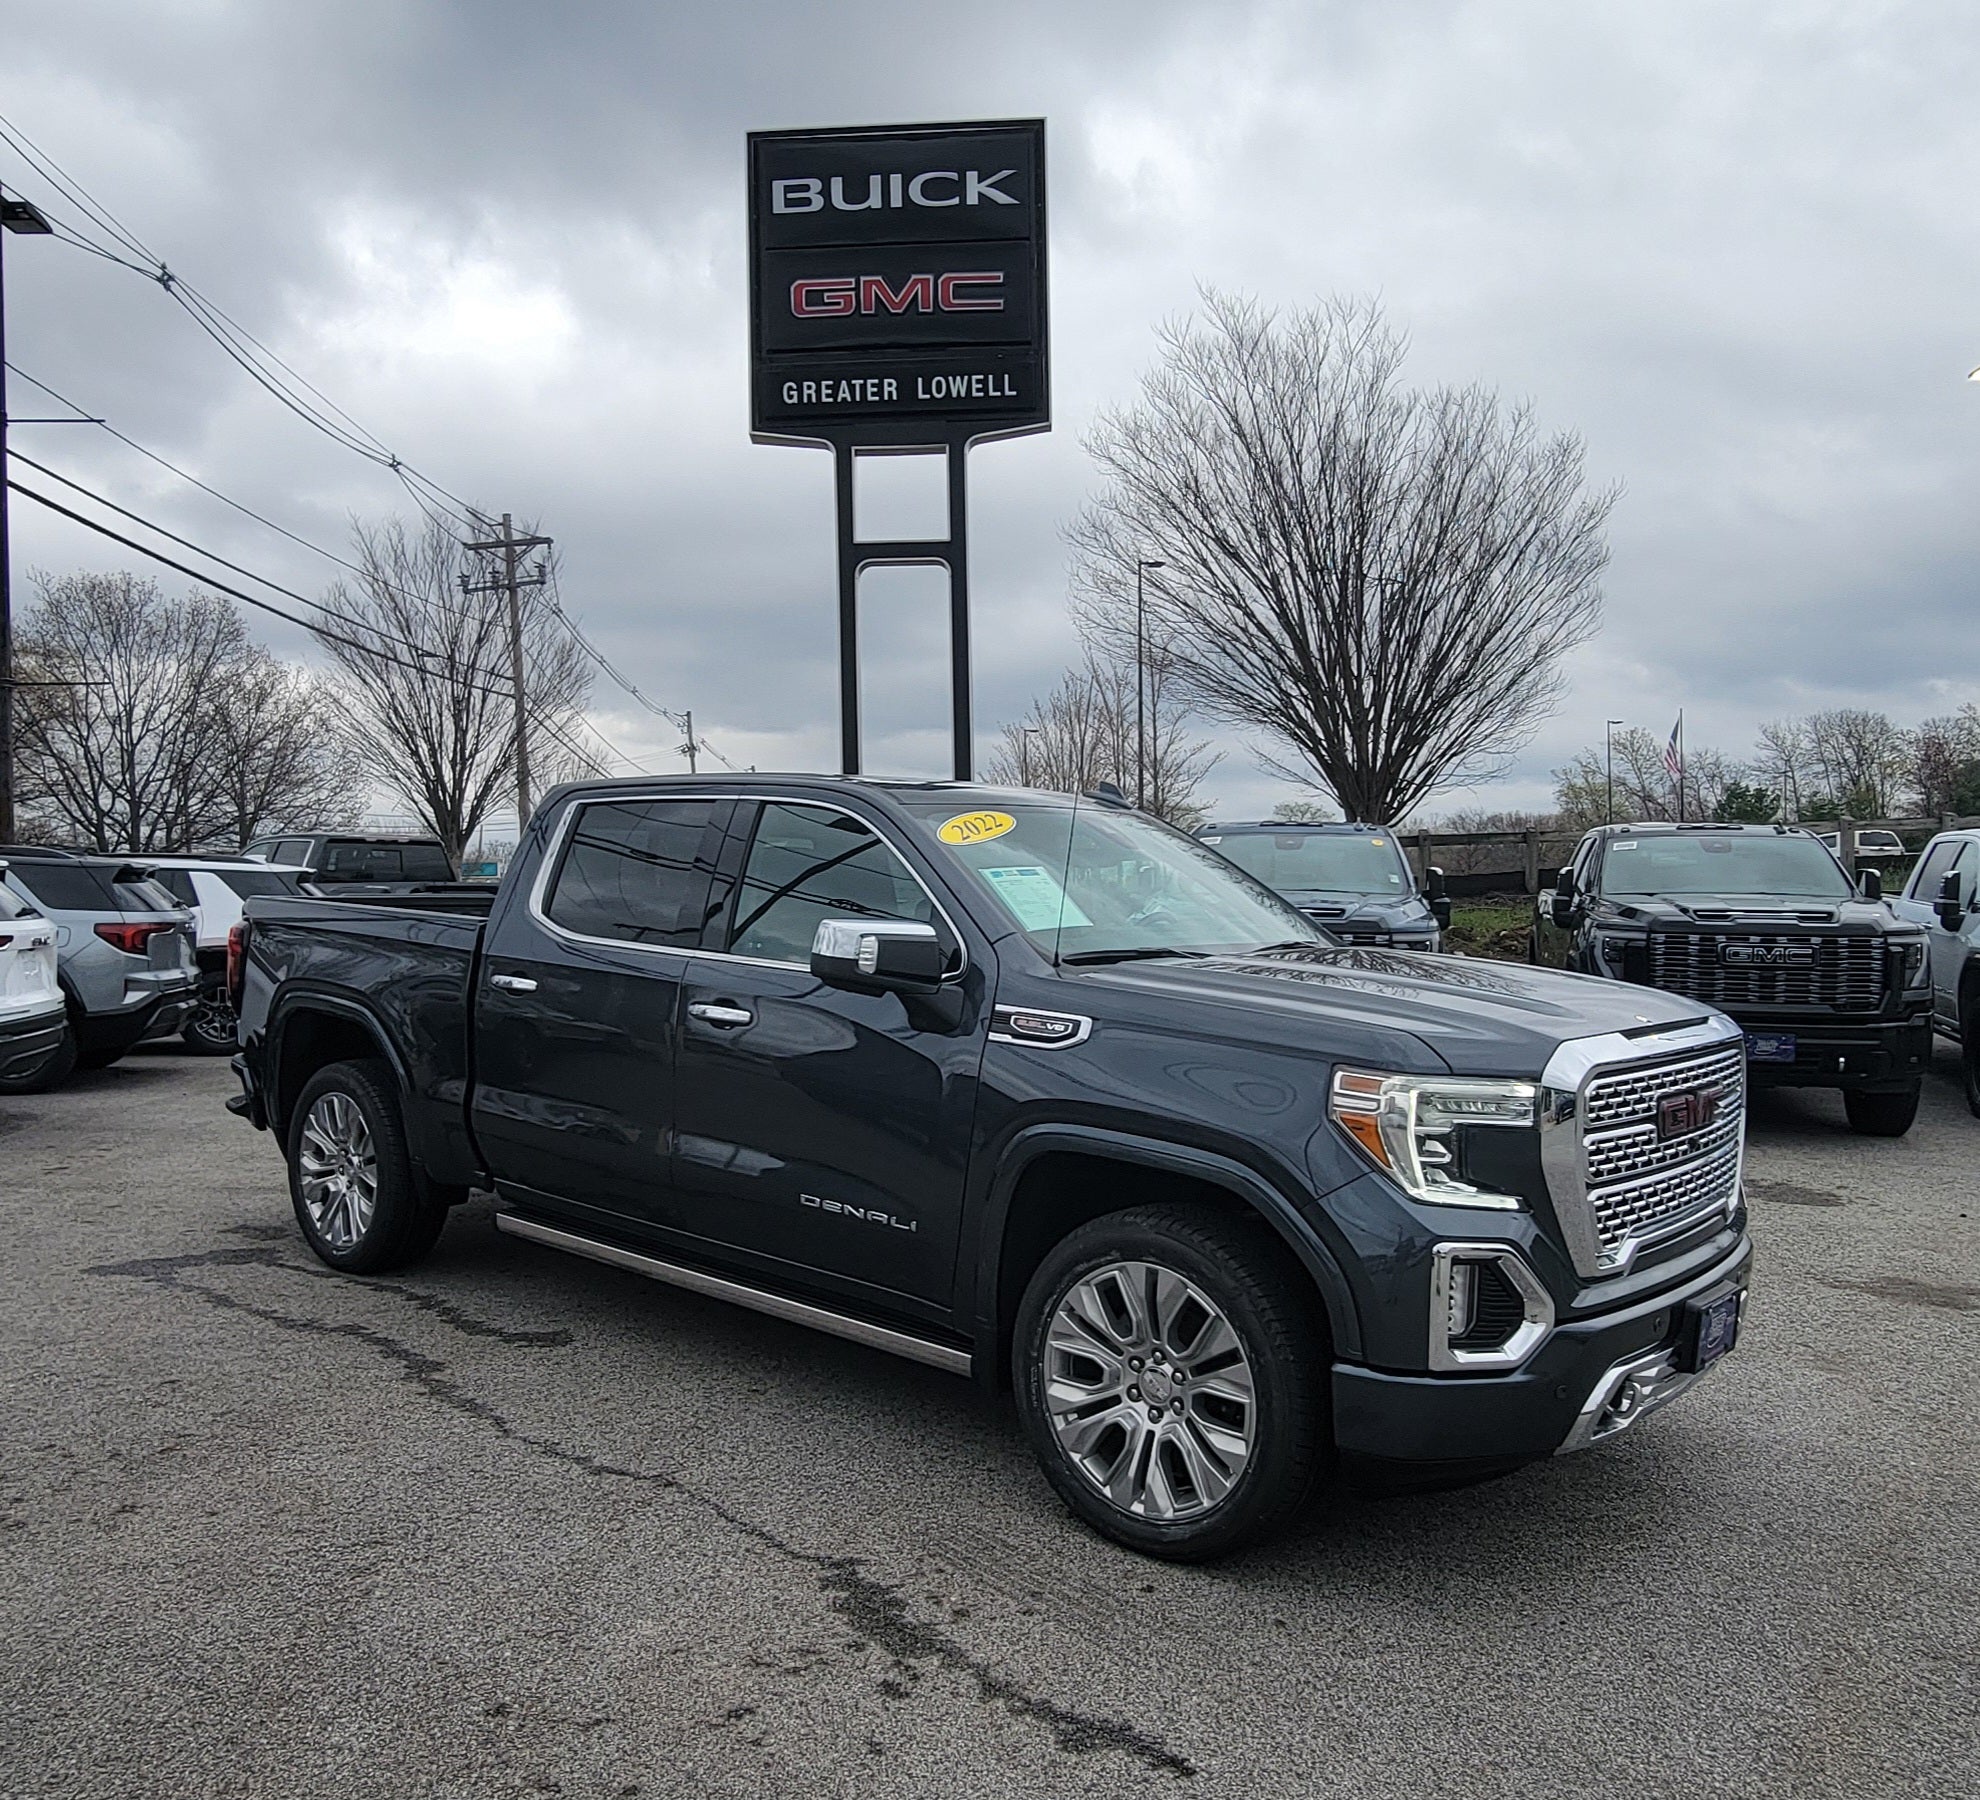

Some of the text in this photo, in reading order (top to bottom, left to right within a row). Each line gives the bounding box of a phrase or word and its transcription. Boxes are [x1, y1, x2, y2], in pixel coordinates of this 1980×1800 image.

[772, 169, 1020, 214] BUICK
[790, 271, 1004, 318] GMC
[782, 374, 1017, 404] GREATER LOWELL
[951, 814, 1003, 841] 2022
[1726, 946, 1813, 963] GMC
[799, 1193, 917, 1233] DENALI
